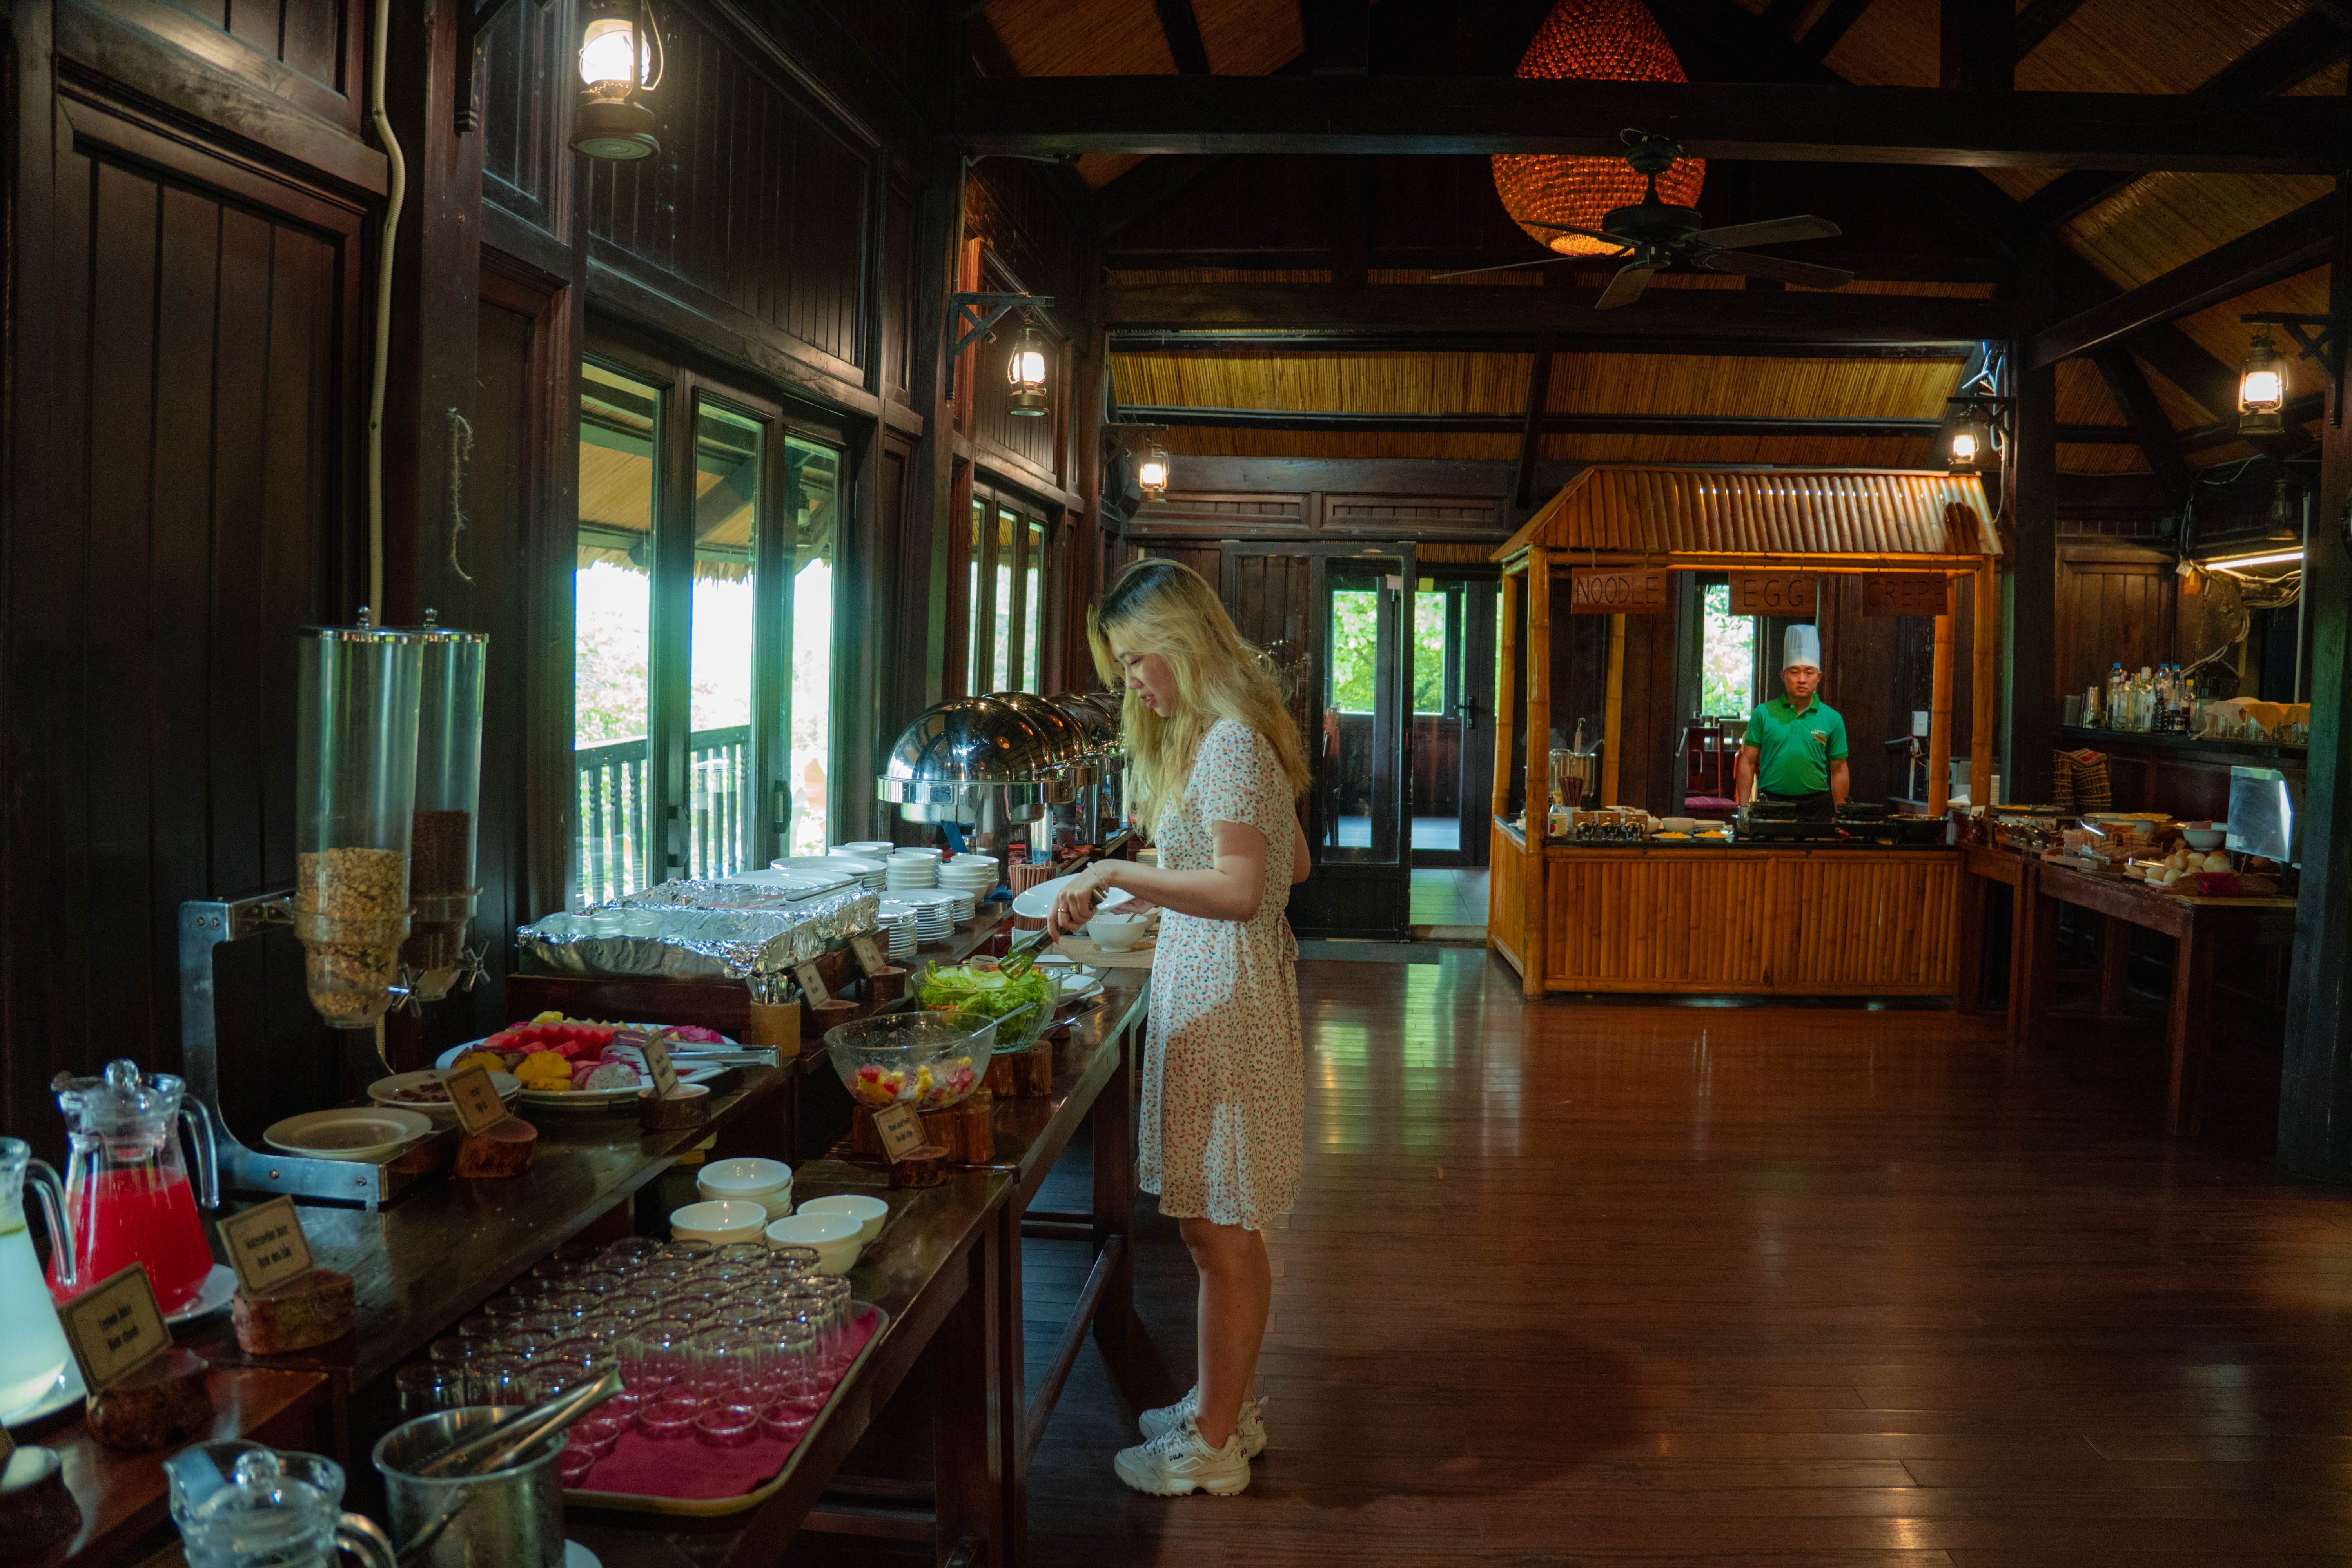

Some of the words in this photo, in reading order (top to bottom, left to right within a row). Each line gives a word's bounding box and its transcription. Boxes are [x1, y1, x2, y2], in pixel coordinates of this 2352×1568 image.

[1576, 577, 1659, 604] NOODLE
[1744, 579, 1803, 607] EGG
[1867, 581, 1944, 606] CREPE
[1168, 1452, 1184, 1462] FILA
